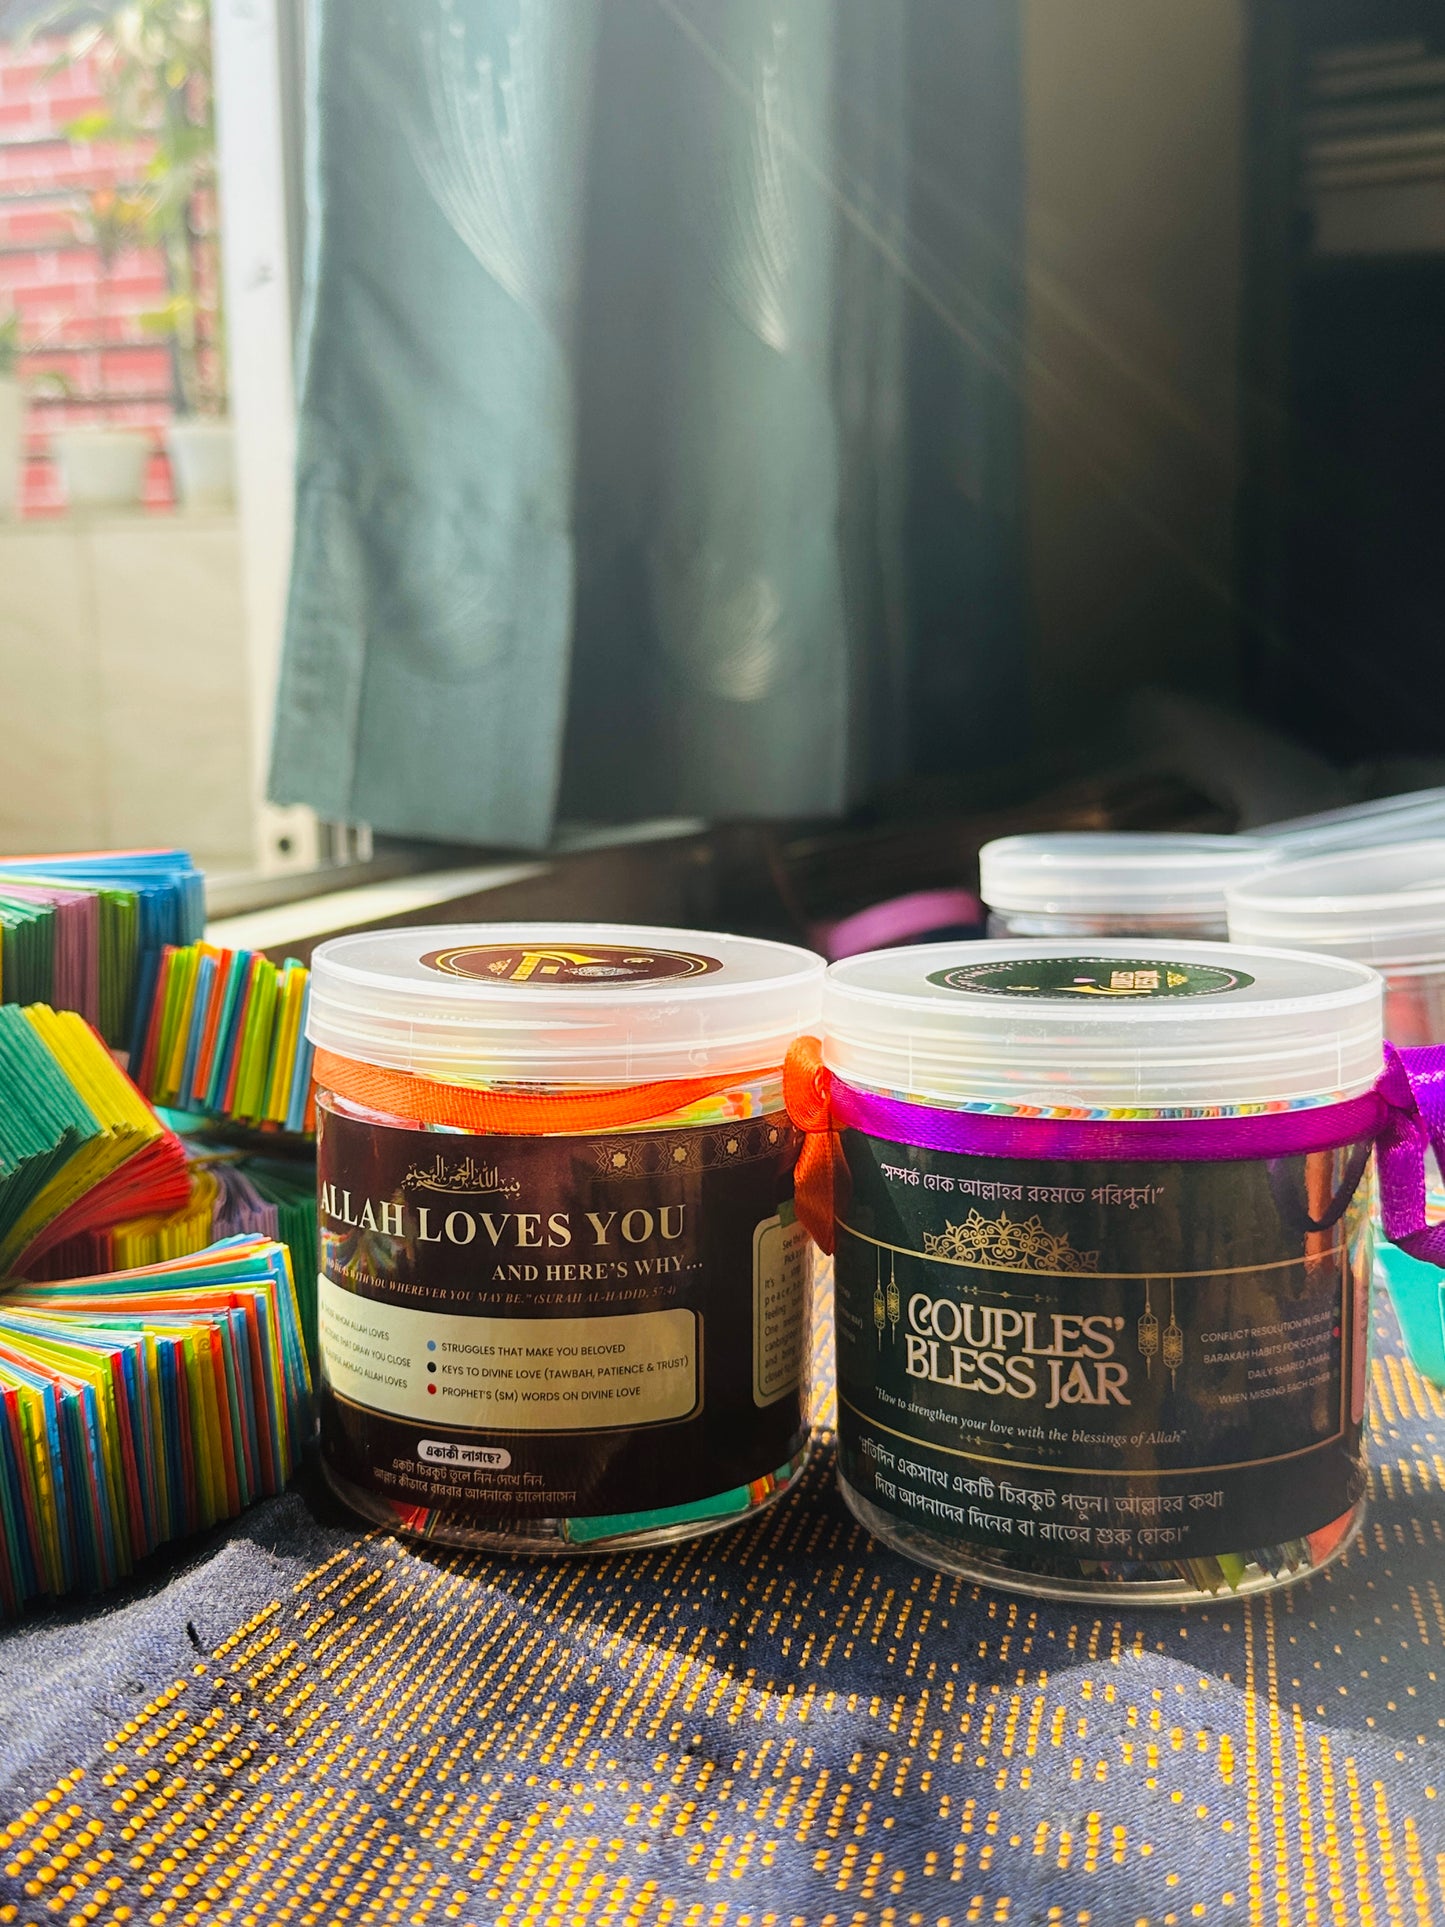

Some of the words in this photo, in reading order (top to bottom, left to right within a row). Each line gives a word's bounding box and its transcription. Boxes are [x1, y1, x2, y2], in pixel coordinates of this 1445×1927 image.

[923, 1173, 955, 1193] হোক
[957, 1178, 1023, 1201] আল্লাহর
[1026, 1185, 1085, 1204] রহমতে
[321, 1180, 405, 1238] ALLAH
[416, 1207, 572, 1248] LOVES
[584, 1204, 686, 1246] YOU
[492, 1264, 538, 1281] AND
[545, 1260, 628, 1281] HERE’S
[350, 1269, 369, 1284] WITH
[370, 1276, 386, 1288] YOU
[389, 1281, 446, 1299] WHEREVER
[450, 1288, 473, 1301] YOU
[478, 1292, 502, 1304] MAY
[534, 1291, 582, 1305] (SURAH
[351, 1321, 368, 1334] ALLAH
[368, 1328, 390, 1341] LOVES
[908, 1292, 1125, 1359] COUPLES’
[1201, 1328, 1250, 1343] CONFLICT
[1251, 1319, 1301, 1337] RESOLUTION
[352, 1342, 370, 1356] DRAW
[371, 1350, 386, 1361] YOU
[387, 1354, 411, 1367] CLOSE
[441, 1342, 496, 1356] STRUGGLES
[498, 1346, 524, 1357] THAT
[525, 1346, 554, 1357] MAKE
[556, 1346, 579, 1357] YOU
[581, 1343, 626, 1356] BELOVED
[1203, 1350, 1249, 1364] BARAKAH
[1251, 1344, 1282, 1358] HABITS
[1283, 1341, 1301, 1354] FOR
[364, 1369, 384, 1382] ALLAH
[384, 1376, 408, 1389] LOVES
[441, 1364, 464, 1377] KEYS
[466, 1366, 480, 1377] TO
[482, 1367, 513, 1379] DIVINE
[515, 1369, 542, 1379] LOVE
[544, 1367, 596, 1380] (TAWBAH,
[597, 1362, 644, 1377] PATIENCE
[646, 1362, 655, 1373] &
[656, 1356, 689, 1371] TRUST)
[905, 1333, 1037, 1400] BLESS
[1045, 1359, 1131, 1409] JAR
[1248, 1367, 1273, 1380] DAILY
[494, 1389, 518, 1402] (SM)
[521, 1391, 560, 1402] WORDS
[562, 1390, 579, 1401] ON
[581, 1388, 614, 1400] DIVINE
[616, 1386, 641, 1398] LOVE
[1218, 1392, 1248, 1404] WHEN
[1249, 1385, 1286, 1400] MISSING
[1287, 1380, 1308, 1392] EACH
[897, 1397, 906, 1409] to
[907, 1401, 958, 1425] strengthen
[960, 1417, 988, 1433] your
[989, 1419, 1014, 1436] love
[1017, 1424, 1045, 1440] with
[1049, 1427, 1068, 1441] the
[1071, 1429, 1127, 1448] blessings
[1130, 1431, 1146, 1448] of
[426, 1445, 459, 1460] একাকী
[462, 1450, 501, 1464] লাগছে?
[416, 1462, 448, 1481] চিরকুট
[465, 1488, 513, 1502] আপনাকে
[897, 1458, 949, 1489] একসাথে
[952, 1476, 995, 1499] একটি
[999, 1480, 1057, 1511] চিরকুট
[1113, 1495, 1184, 1516] আল্লাহর
[1187, 1489, 1224, 1510] কথা
[898, 1486, 965, 1524] আপনাদের
[967, 1506, 1013, 1534] দিনের
[1017, 1519, 1036, 1537] বা
[1039, 1522, 1092, 1543] রাতের
[1096, 1527, 1133, 1545] শুরু
